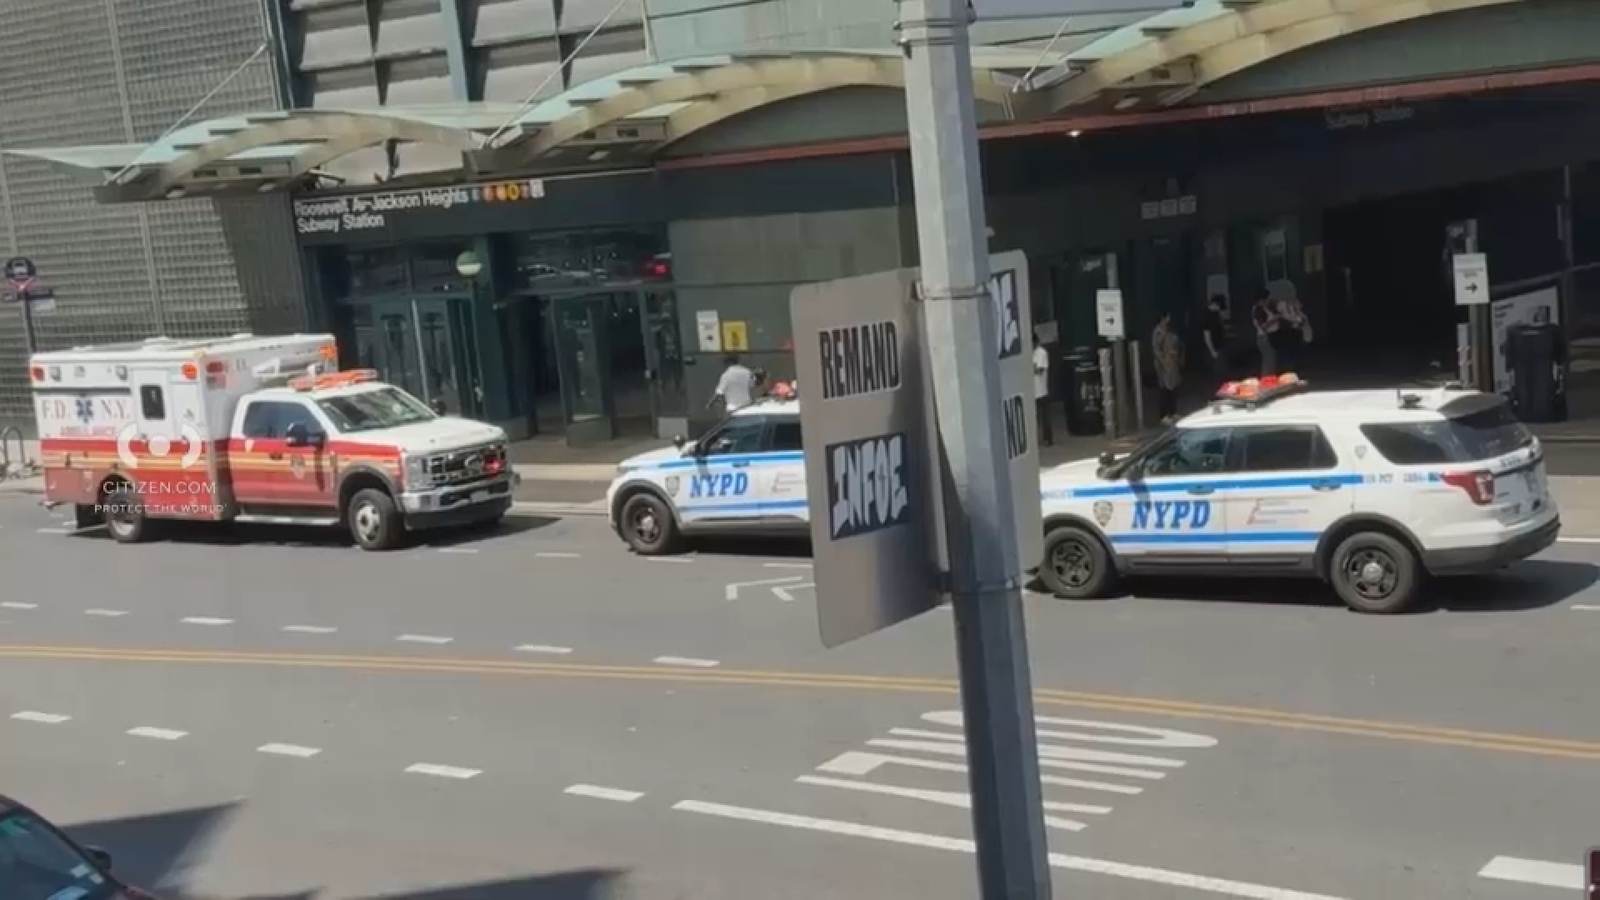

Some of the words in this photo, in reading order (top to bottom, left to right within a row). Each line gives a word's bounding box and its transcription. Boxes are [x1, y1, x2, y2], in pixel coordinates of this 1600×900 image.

[422, 188, 469, 209] Heights
[297, 217, 340, 233] Subway
[342, 213, 384, 230] Station
[818, 321, 900, 399] REMAND
[689, 472, 748, 498] NYPD
[1131, 500, 1211, 529] NYPD
